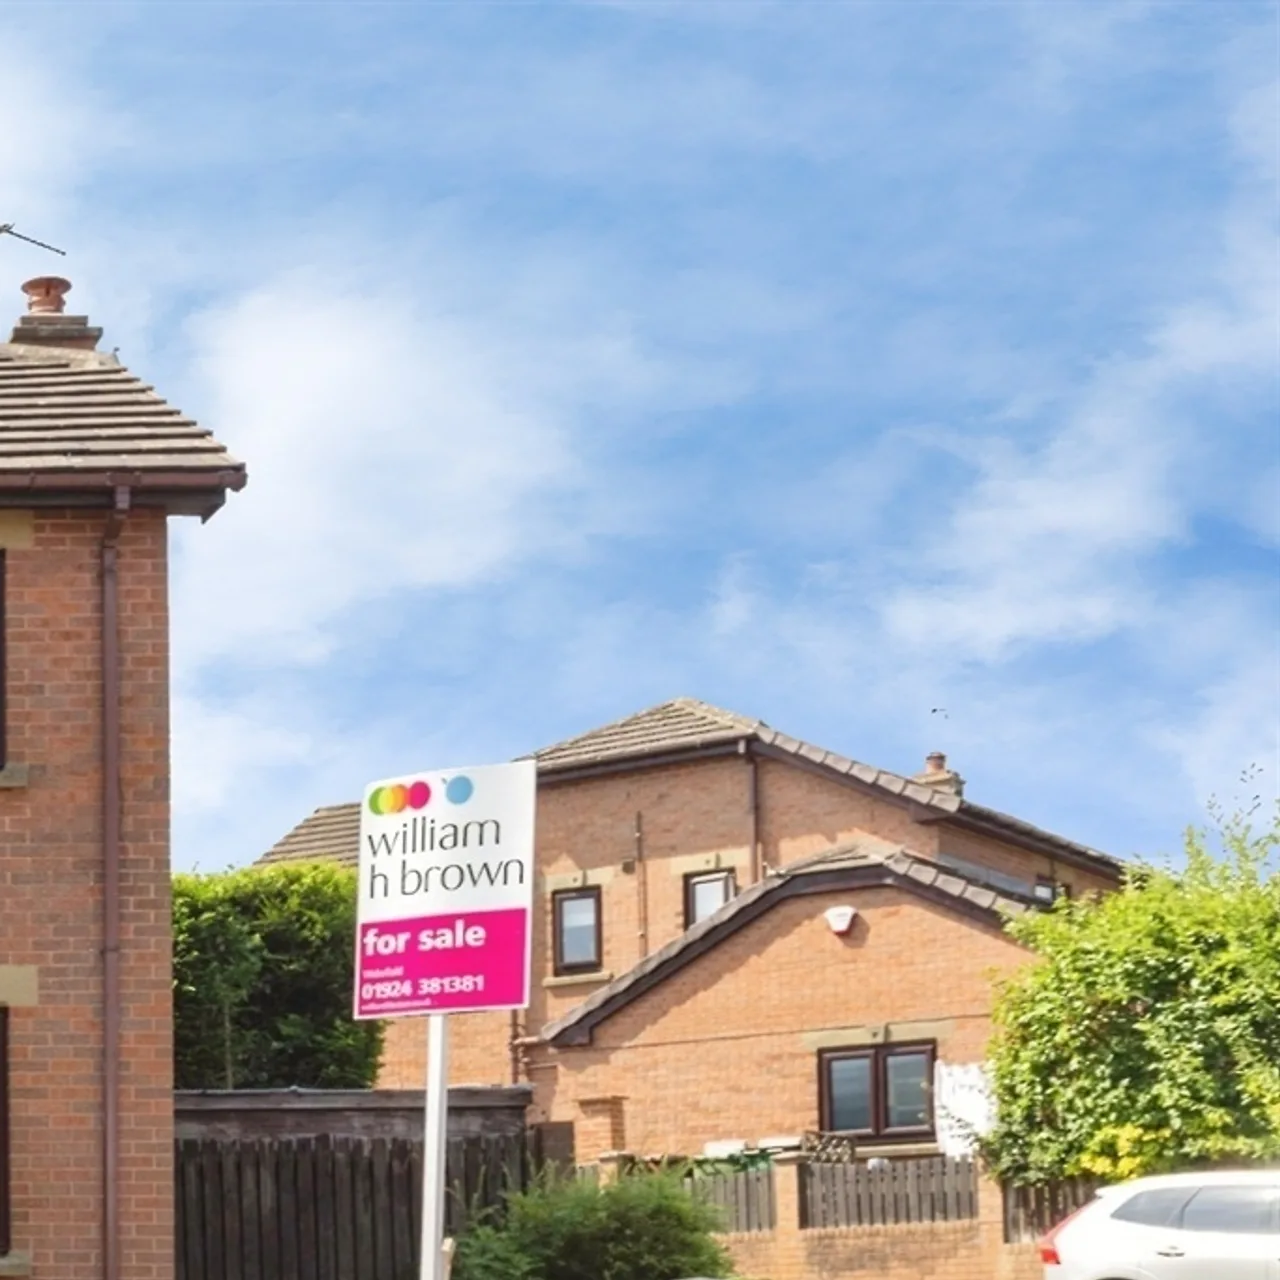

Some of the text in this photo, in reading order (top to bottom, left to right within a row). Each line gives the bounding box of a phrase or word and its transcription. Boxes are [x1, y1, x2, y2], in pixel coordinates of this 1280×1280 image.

[367, 816, 501, 857] william
[369, 858, 525, 899] h brown
[363, 919, 487, 956] for sale
